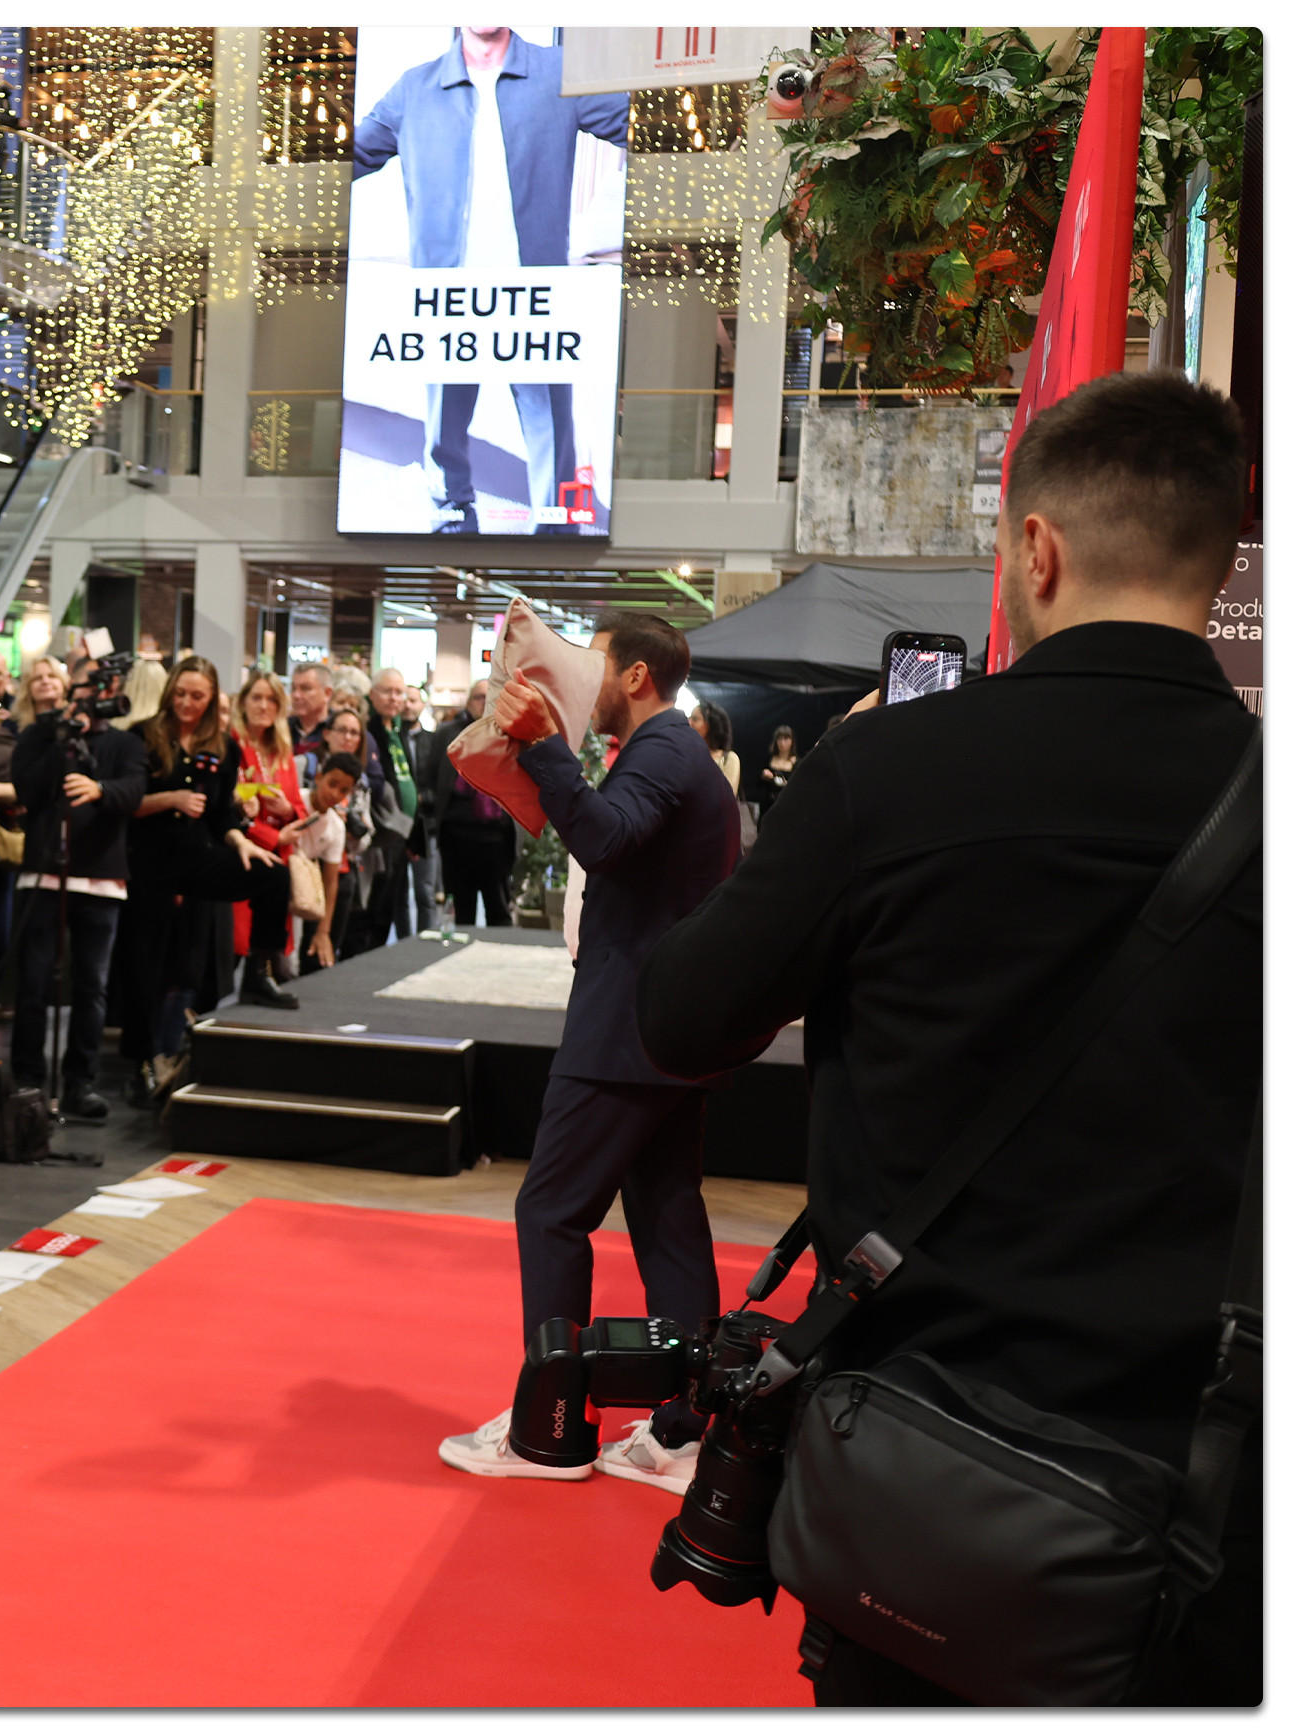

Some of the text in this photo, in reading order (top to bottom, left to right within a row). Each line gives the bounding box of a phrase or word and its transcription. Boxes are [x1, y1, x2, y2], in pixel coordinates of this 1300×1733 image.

[414, 286, 552, 317] HEUTE
[370, 331, 582, 362] AB 18 UHR
[1206, 620, 1263, 640] Deta
[551, 1398, 566, 1439] Godox
